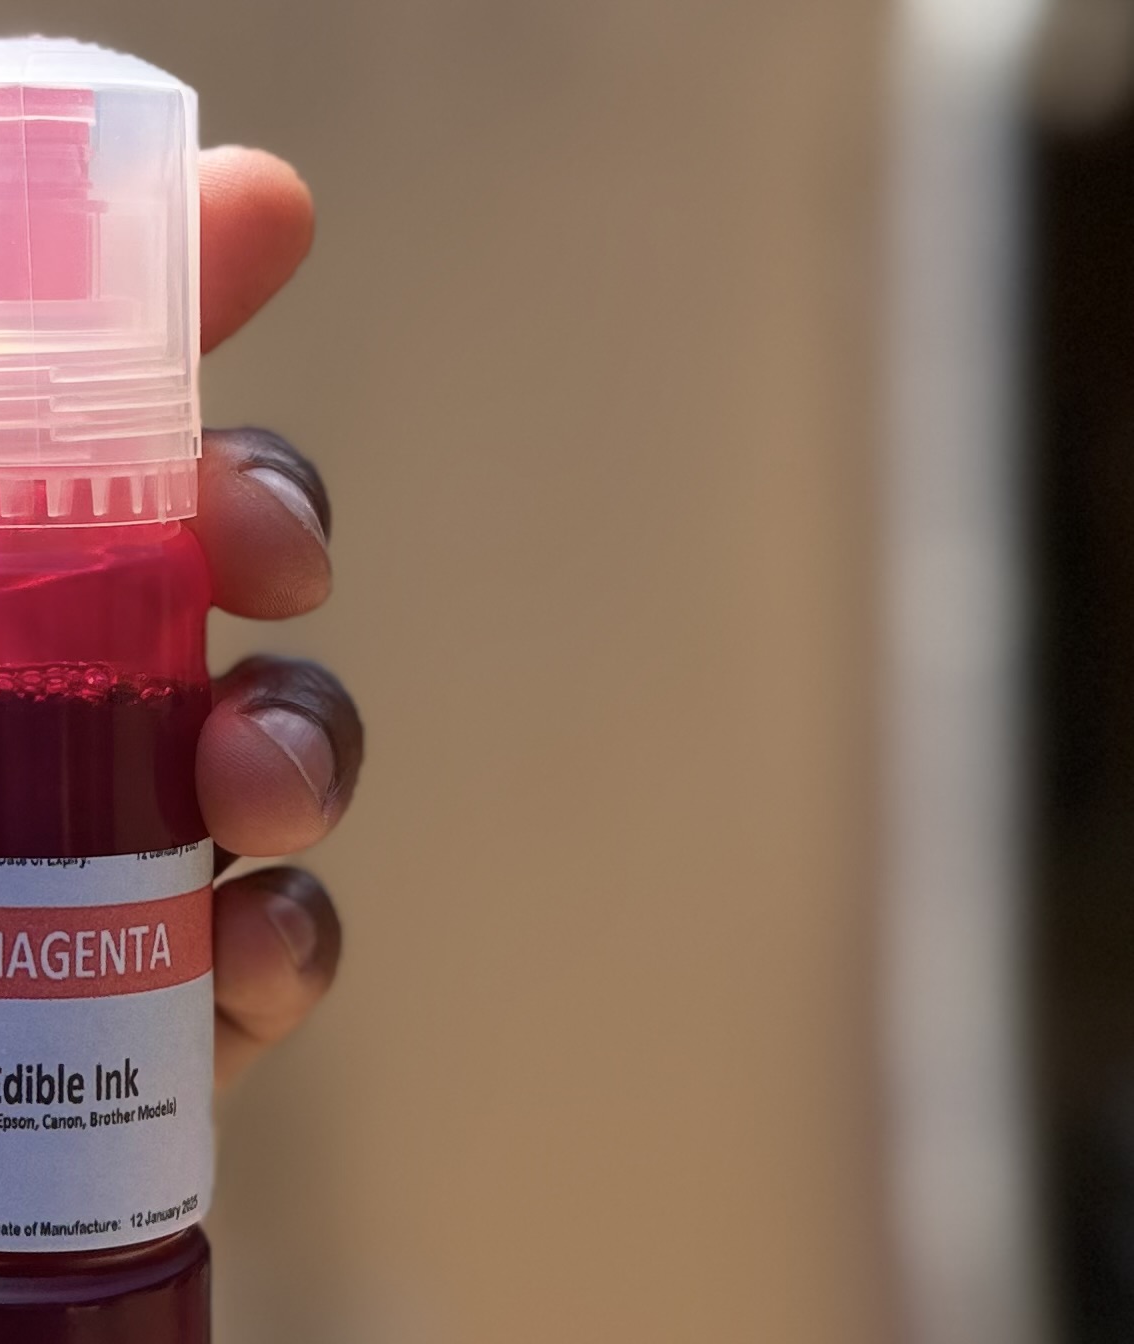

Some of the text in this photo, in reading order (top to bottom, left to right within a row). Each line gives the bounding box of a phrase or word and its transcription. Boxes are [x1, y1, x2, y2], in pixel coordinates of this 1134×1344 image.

[96, 1058, 139, 1101] Ink
[42, 1113, 86, 1131] Canon,
[89, 1108, 136, 1127] Brother
[138, 1097, 177, 1121] Models)
[24, 1220, 38, 1237] of
[39, 1218, 122, 1237] Manufacture:
[130, 1212, 143, 1228] 12
[145, 1205, 181, 1226] January
